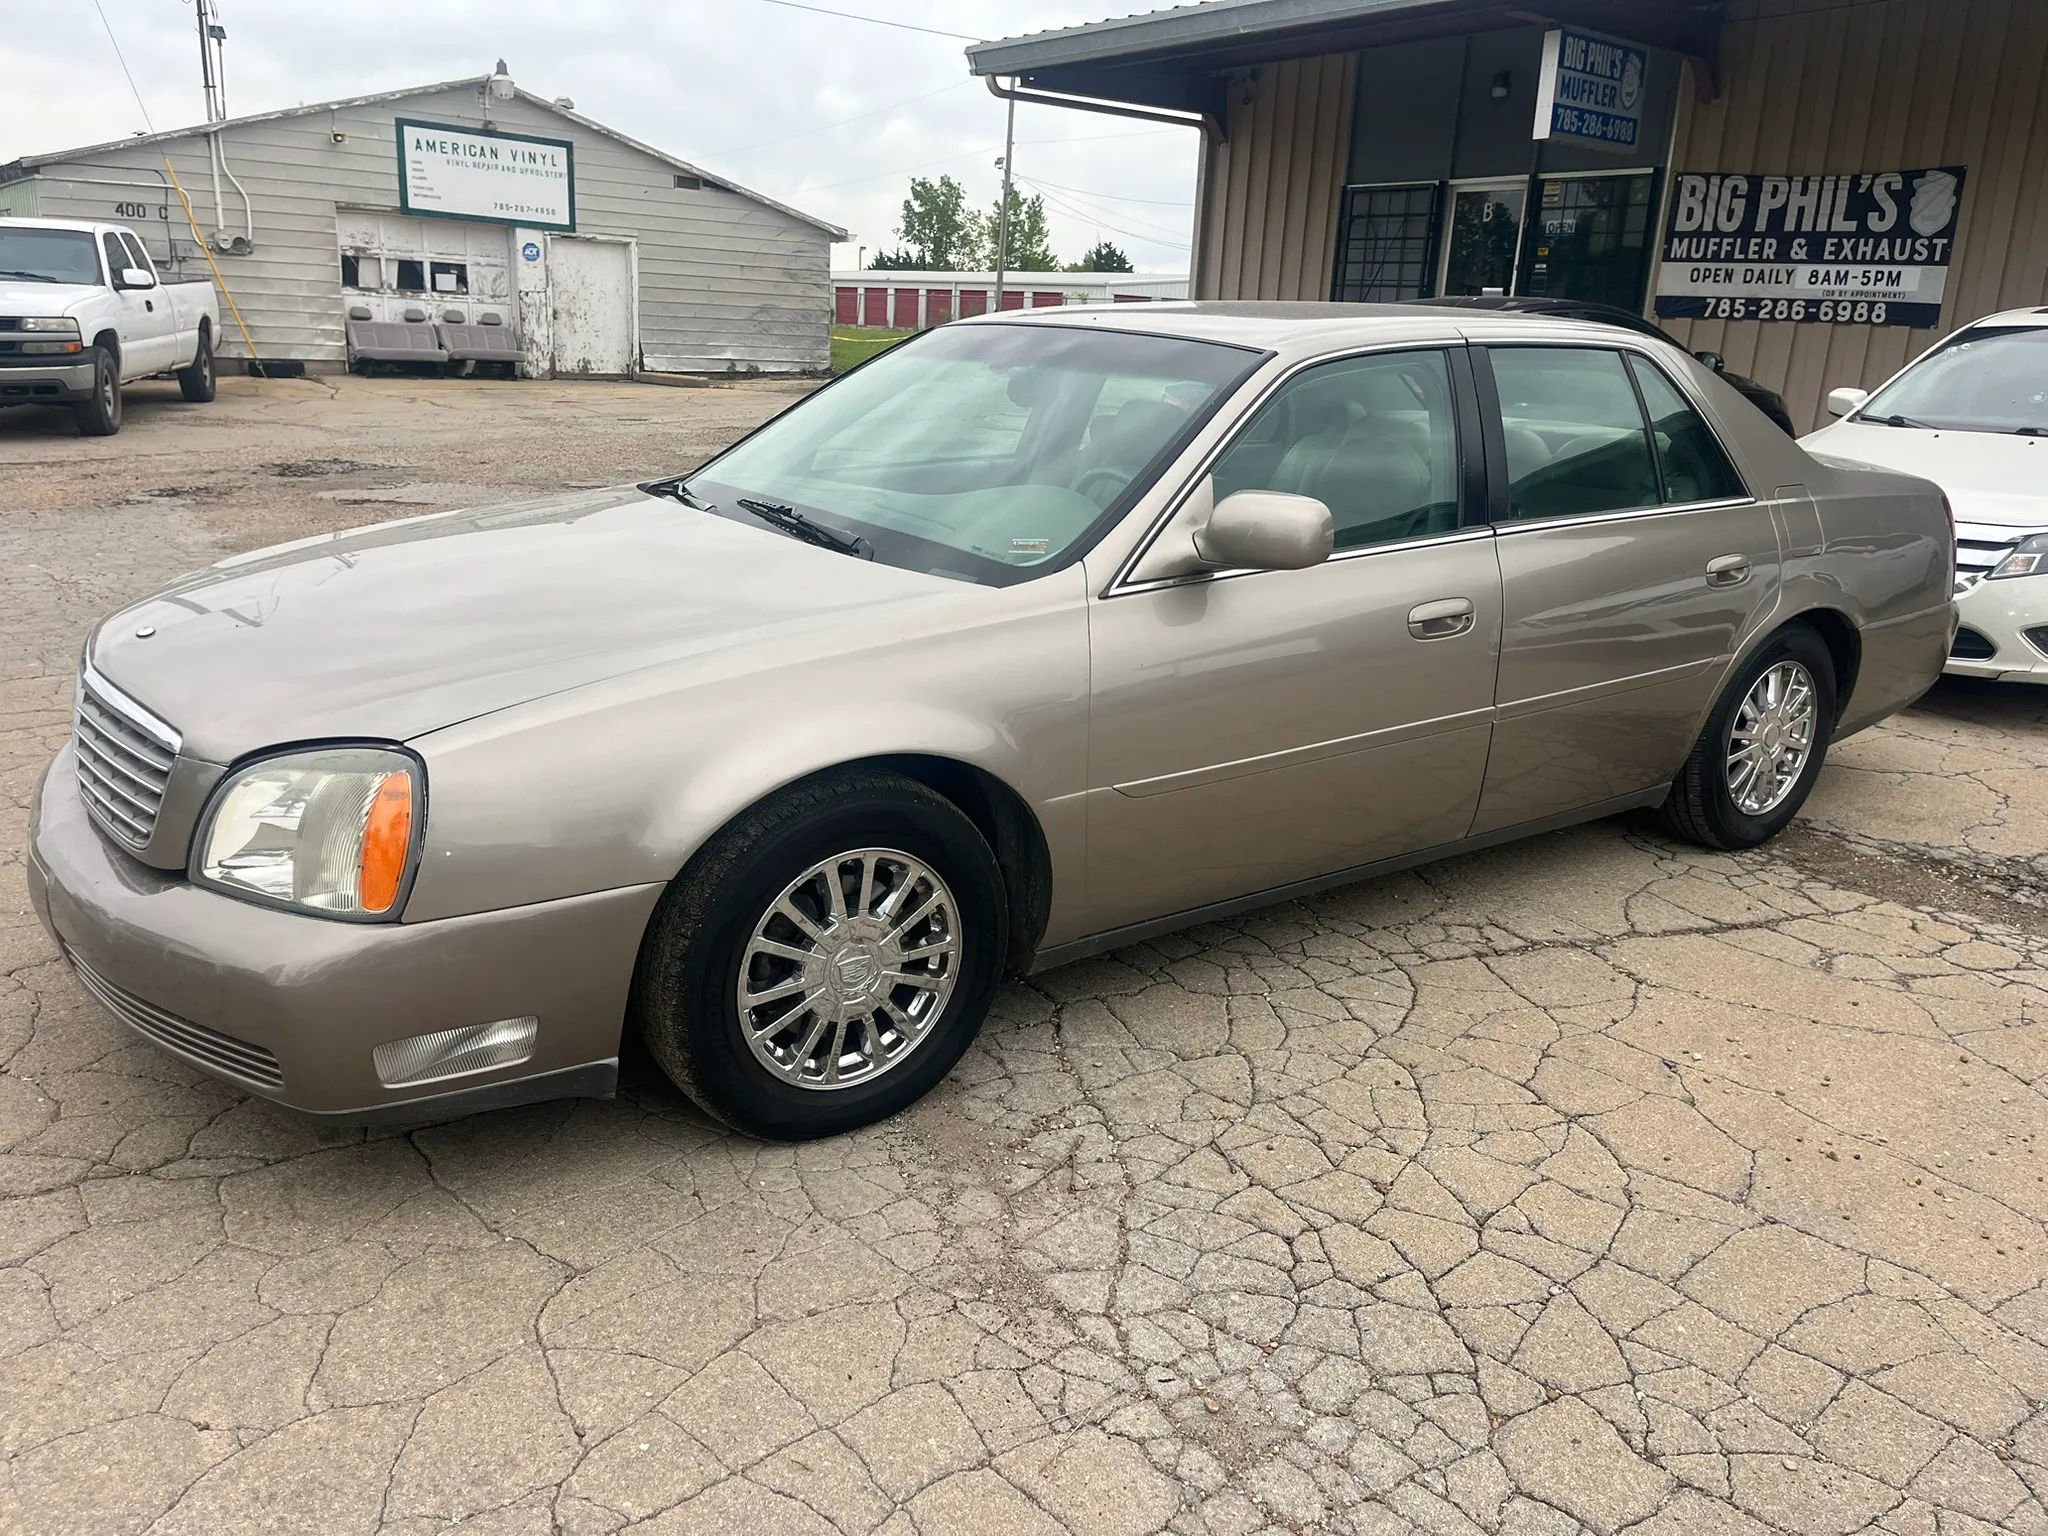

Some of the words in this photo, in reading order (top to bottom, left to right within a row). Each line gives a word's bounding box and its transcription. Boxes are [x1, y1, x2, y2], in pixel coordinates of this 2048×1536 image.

[1564, 36, 1586, 69] BIG
[1586, 42, 1623, 79] PHIL'S
[1560, 74, 1618, 109] MUFFLER
[1557, 107, 1634, 141] 785-286-6988
[415, 137, 499, 160] AMERICAN
[510, 149, 558, 167] VINYL
[446, 159, 470, 168] VINYL
[472, 162, 499, 171] REPAIR
[501, 165, 517, 174] AND
[115, 202, 146, 219] 400
[158, 207, 169, 220] C
[1674, 175, 1749, 233] BIG
[1754, 172, 1903, 233] PHIL'S
[1547, 221, 1575, 234] OPEN
[1669, 238, 1778, 261] MUFFLER
[1789, 238, 1808, 260] &
[1823, 238, 1949, 262] EXHAUST
[1689, 268, 1734, 284] OPEN
[1742, 268, 1796, 285] DAILY
[1807, 269, 1902, 287] 8AM-5PM
[1702, 298, 1887, 324] 785-286-6988
